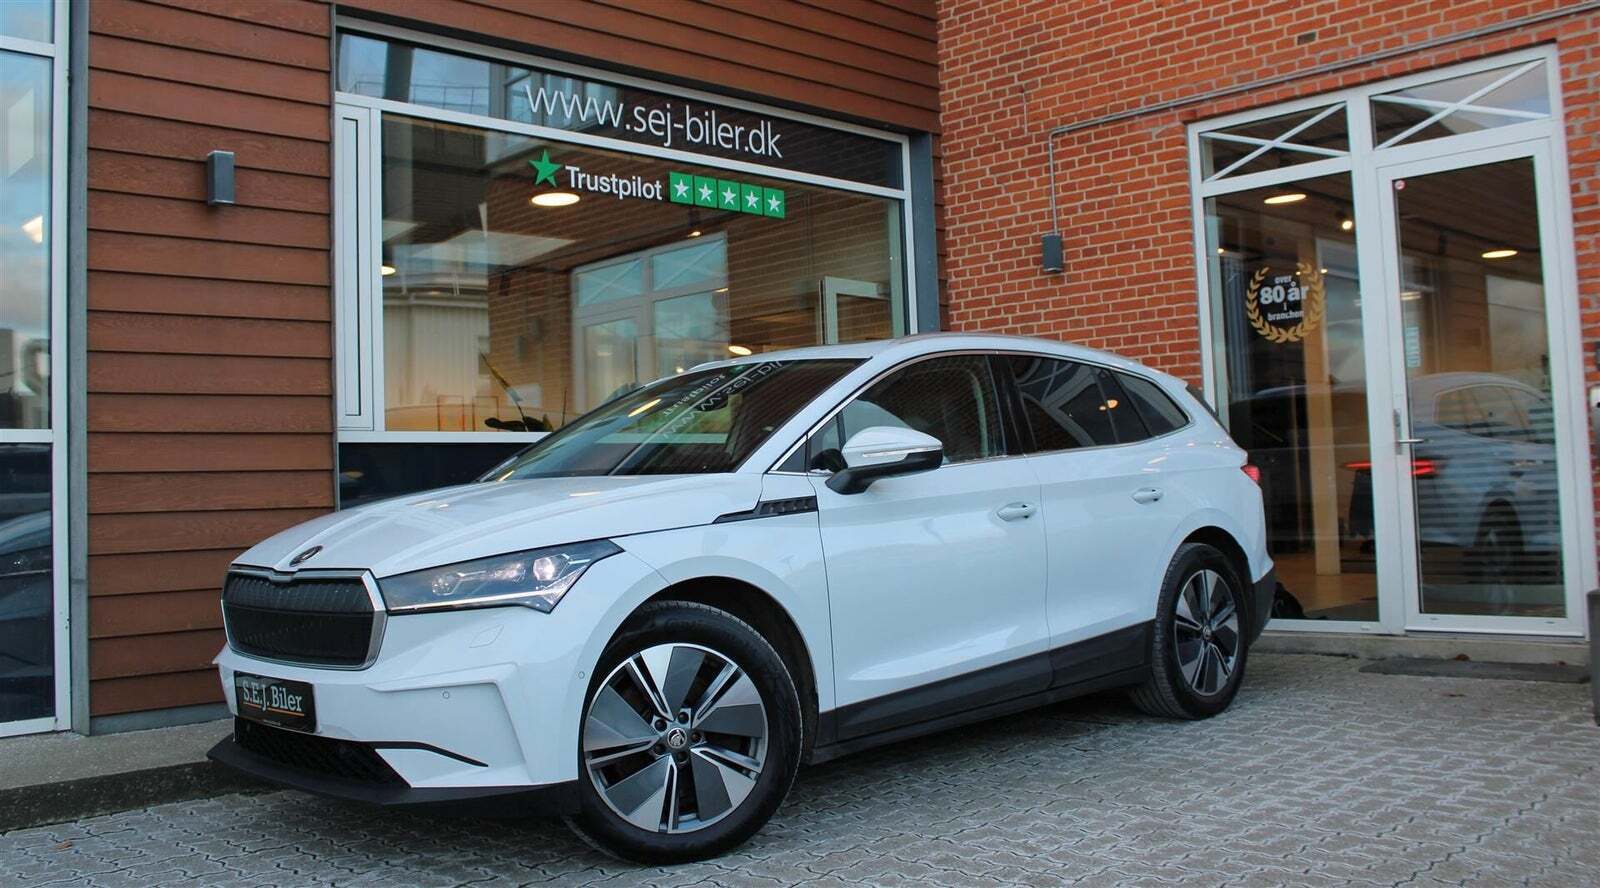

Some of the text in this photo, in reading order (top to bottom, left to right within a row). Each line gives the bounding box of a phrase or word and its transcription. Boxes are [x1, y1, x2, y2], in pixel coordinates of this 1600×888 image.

[525, 85, 783, 159] www.sej-biler.dk
[565, 164, 663, 201] Trustpilot
[1260, 281, 1309, 305] 80 år
[1274, 275, 1292, 285] over
[242, 680, 303, 712] S.E.J. Biler
